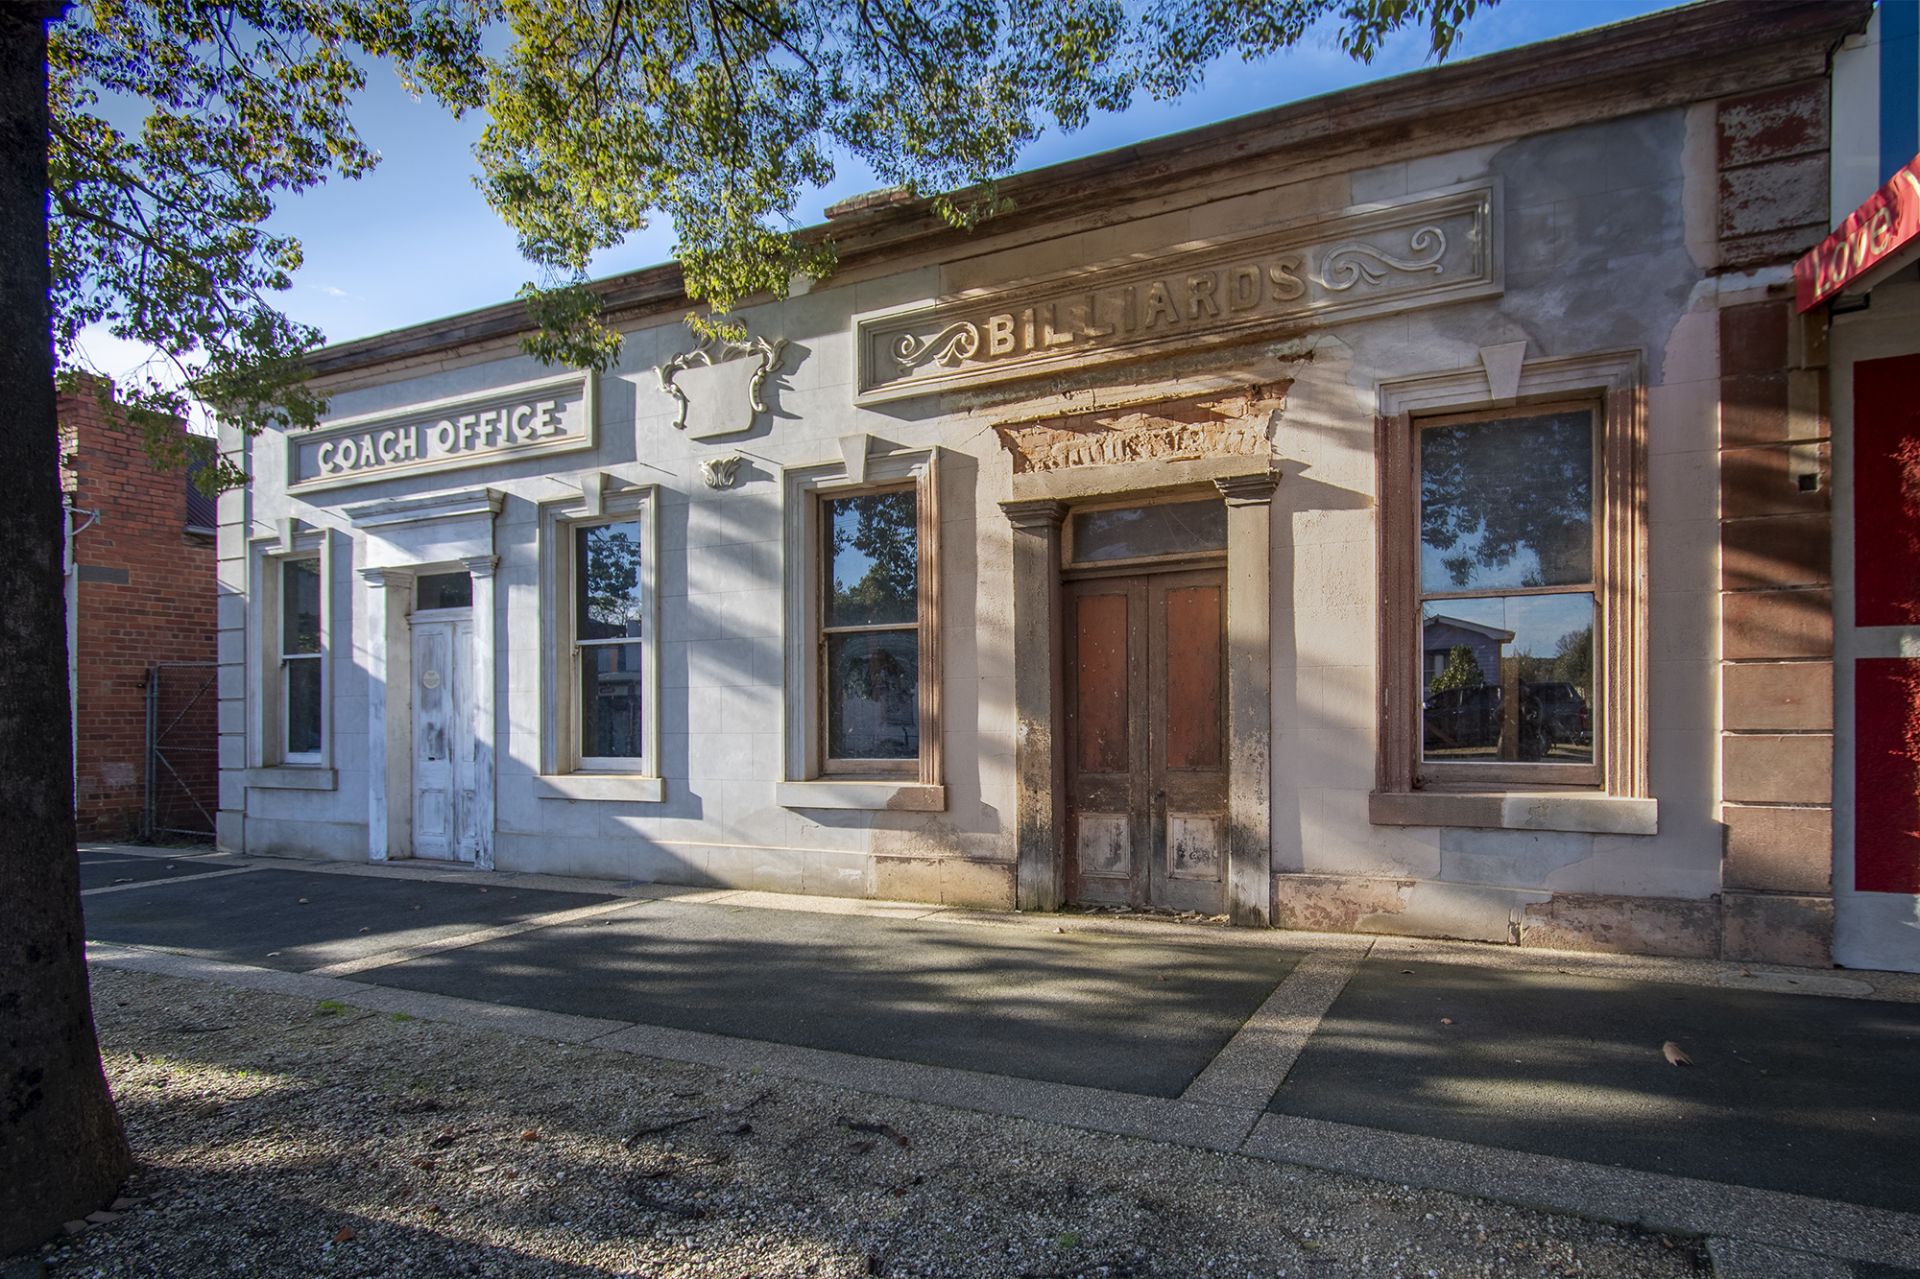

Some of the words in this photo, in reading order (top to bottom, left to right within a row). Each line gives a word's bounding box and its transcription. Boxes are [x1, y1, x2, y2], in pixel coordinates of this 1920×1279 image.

[1811, 206, 1892, 297] Love
[989, 255, 1308, 355] BILLIARDS
[318, 426, 418, 472] COACH
[434, 400, 556, 452] OFFICE
